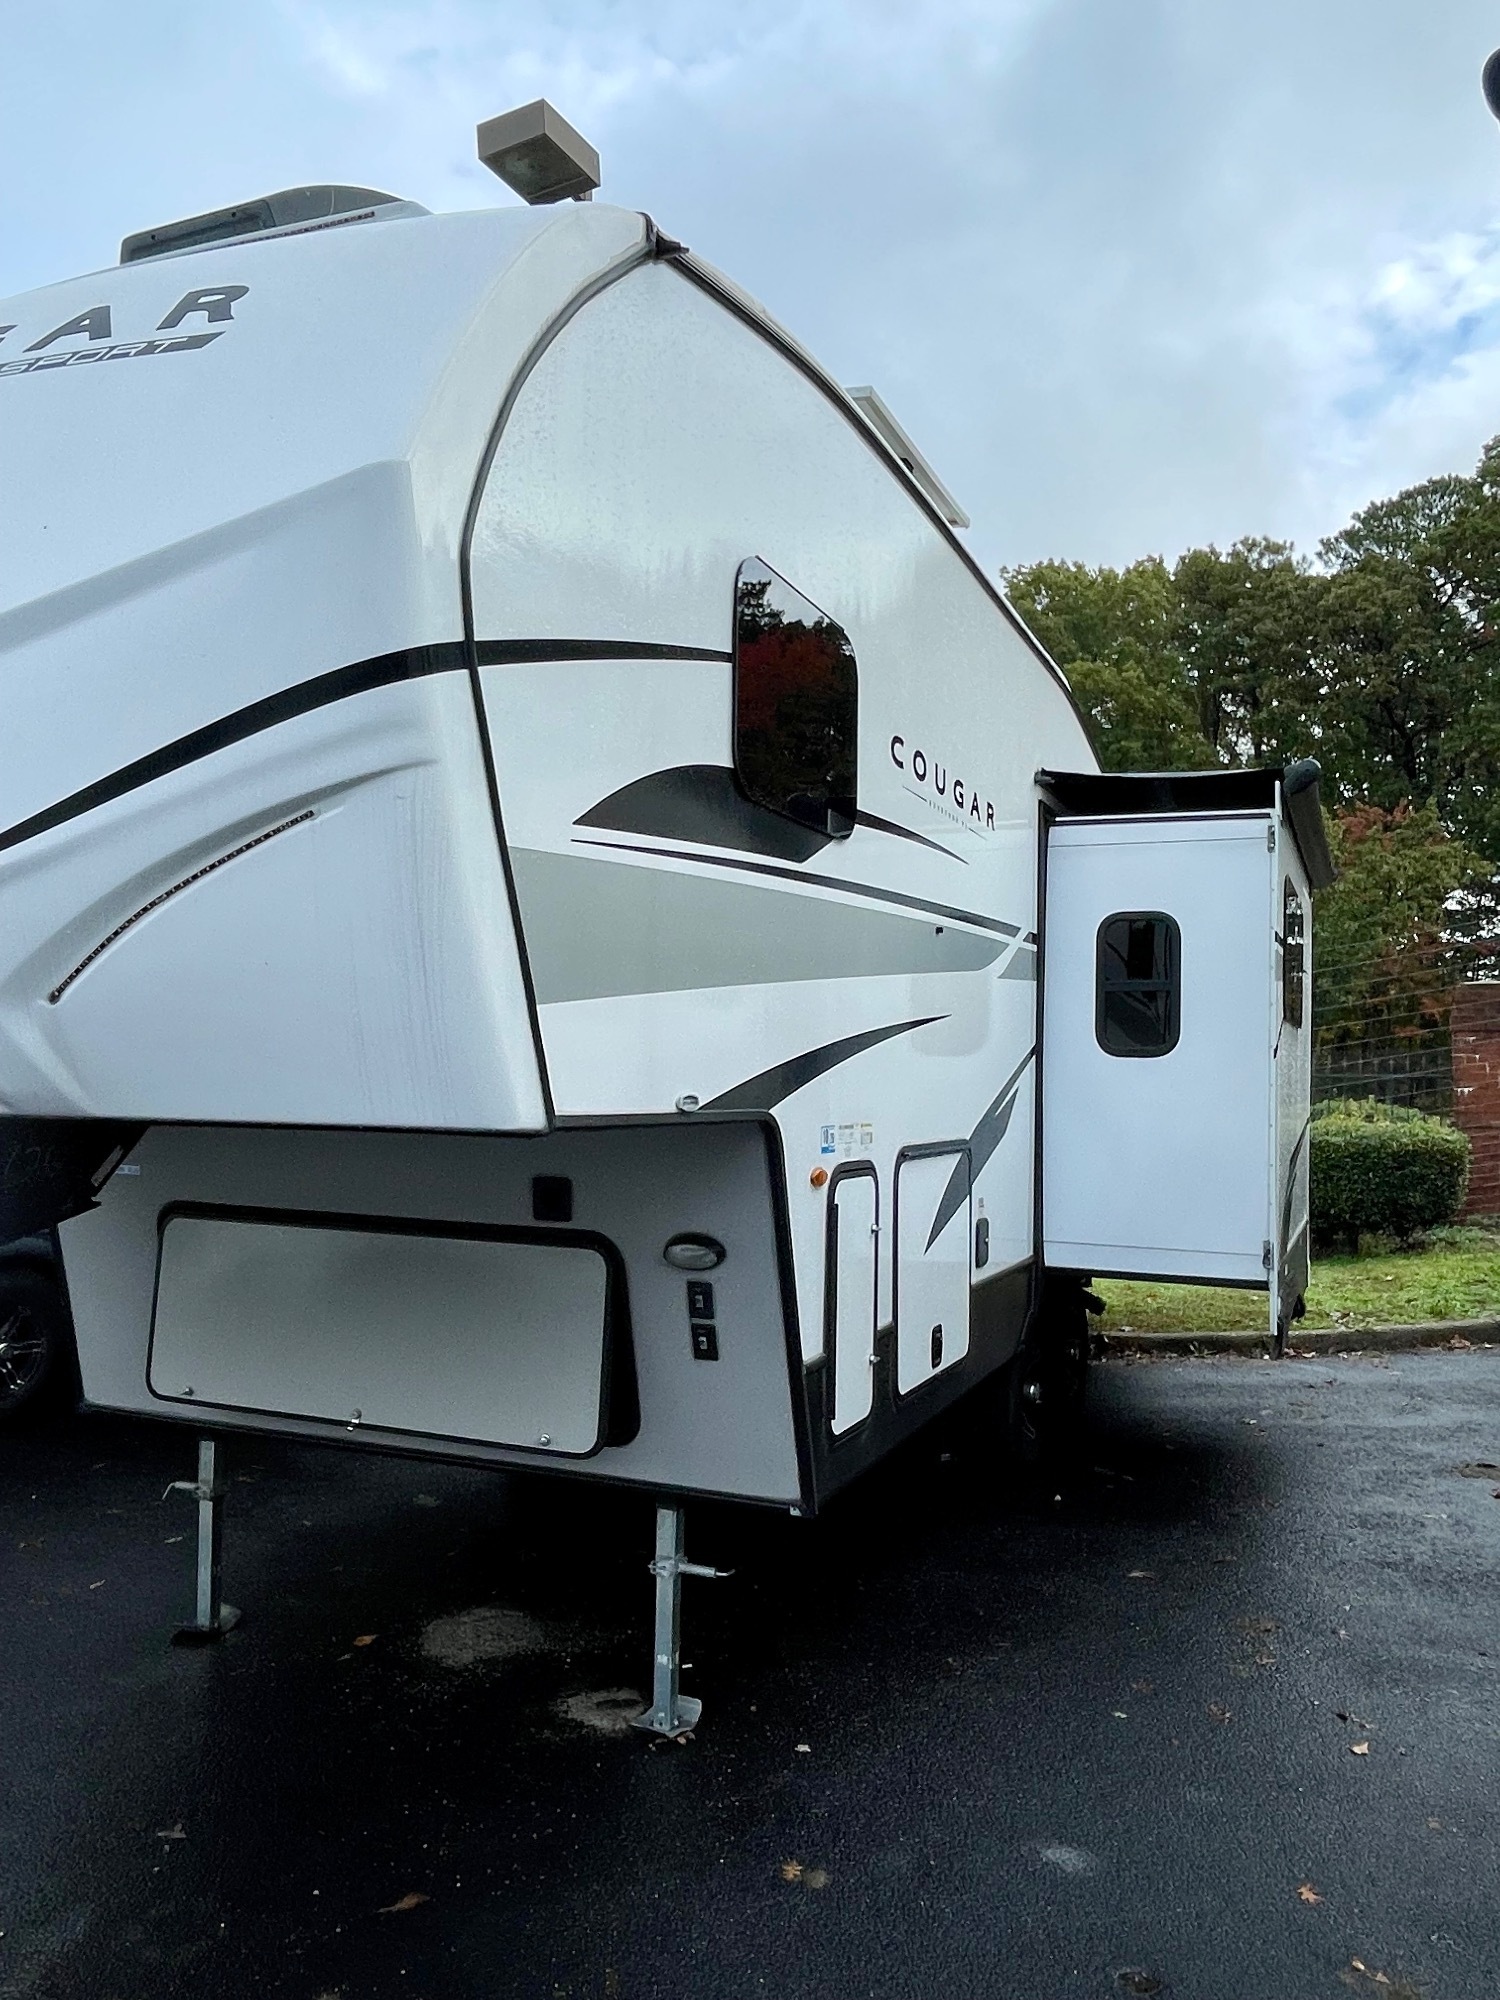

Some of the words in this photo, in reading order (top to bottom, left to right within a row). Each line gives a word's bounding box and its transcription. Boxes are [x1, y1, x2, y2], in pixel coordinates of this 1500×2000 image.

[0, 285, 250, 353] AR
[0, 336, 189, 376] SPORT
[890, 735, 995, 831] COUGAR
